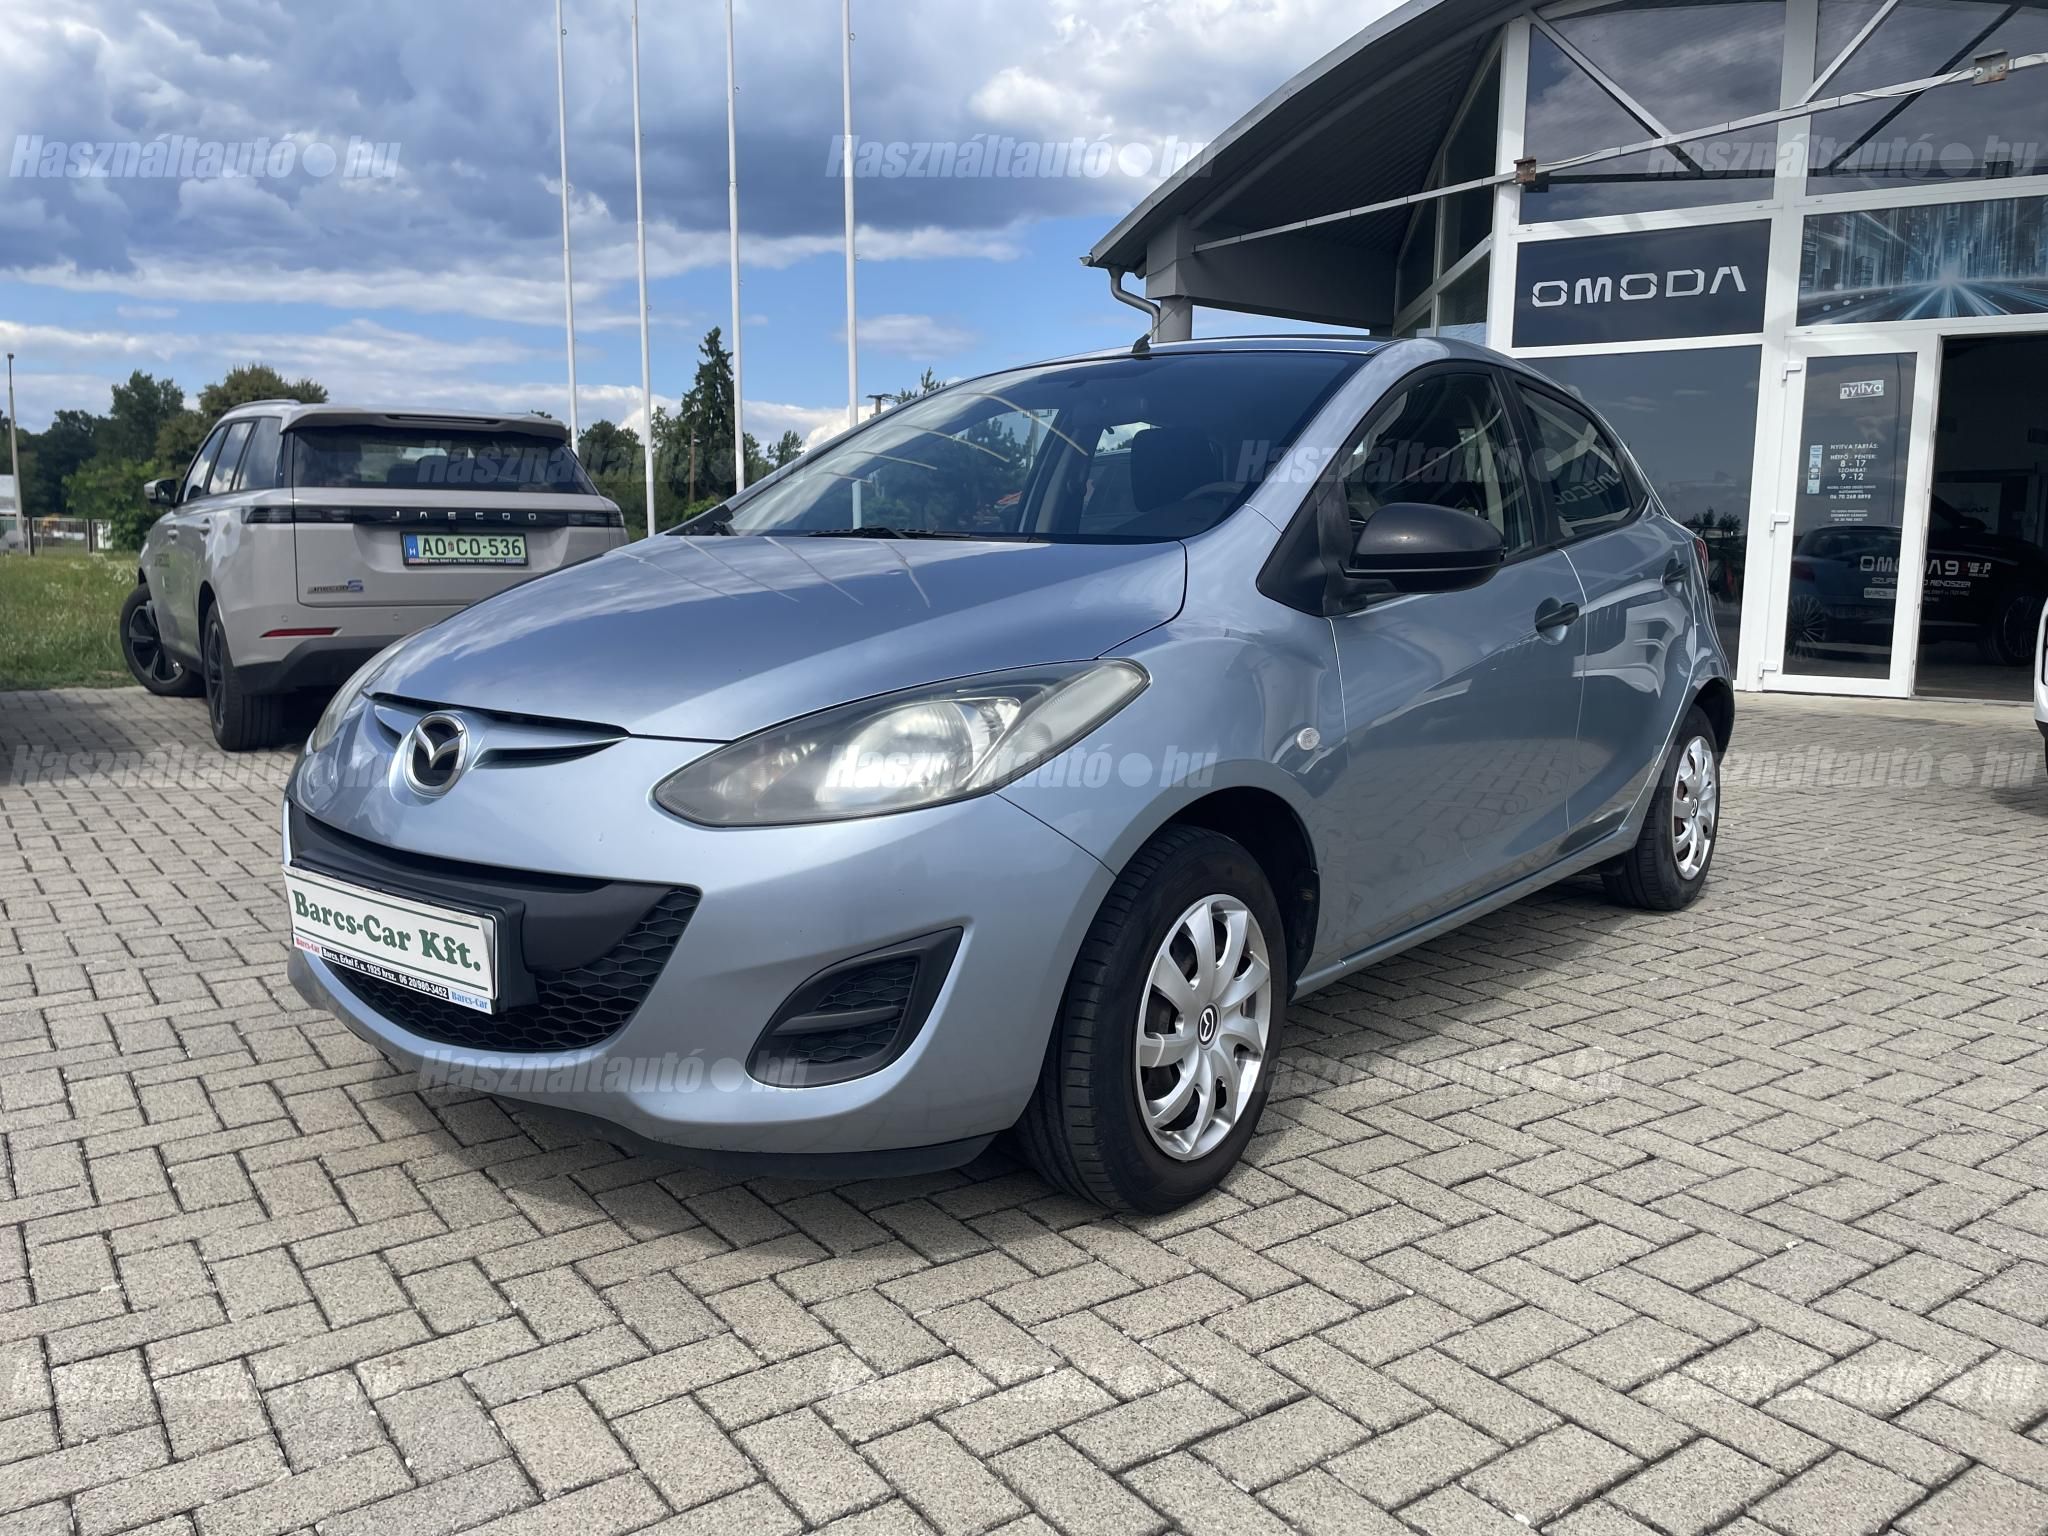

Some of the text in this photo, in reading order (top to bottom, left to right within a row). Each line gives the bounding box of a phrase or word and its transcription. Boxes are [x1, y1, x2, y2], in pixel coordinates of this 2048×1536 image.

[1532, 265, 1747, 308] OMODA
[1841, 382, 1883, 397] nyitva
[292, 889, 481, 972] Barcs-Car Kft.
[366, 964, 382, 976] 1925
[399, 974, 409, 985] 06
[451, 990, 489, 1010] Barcs-Car
